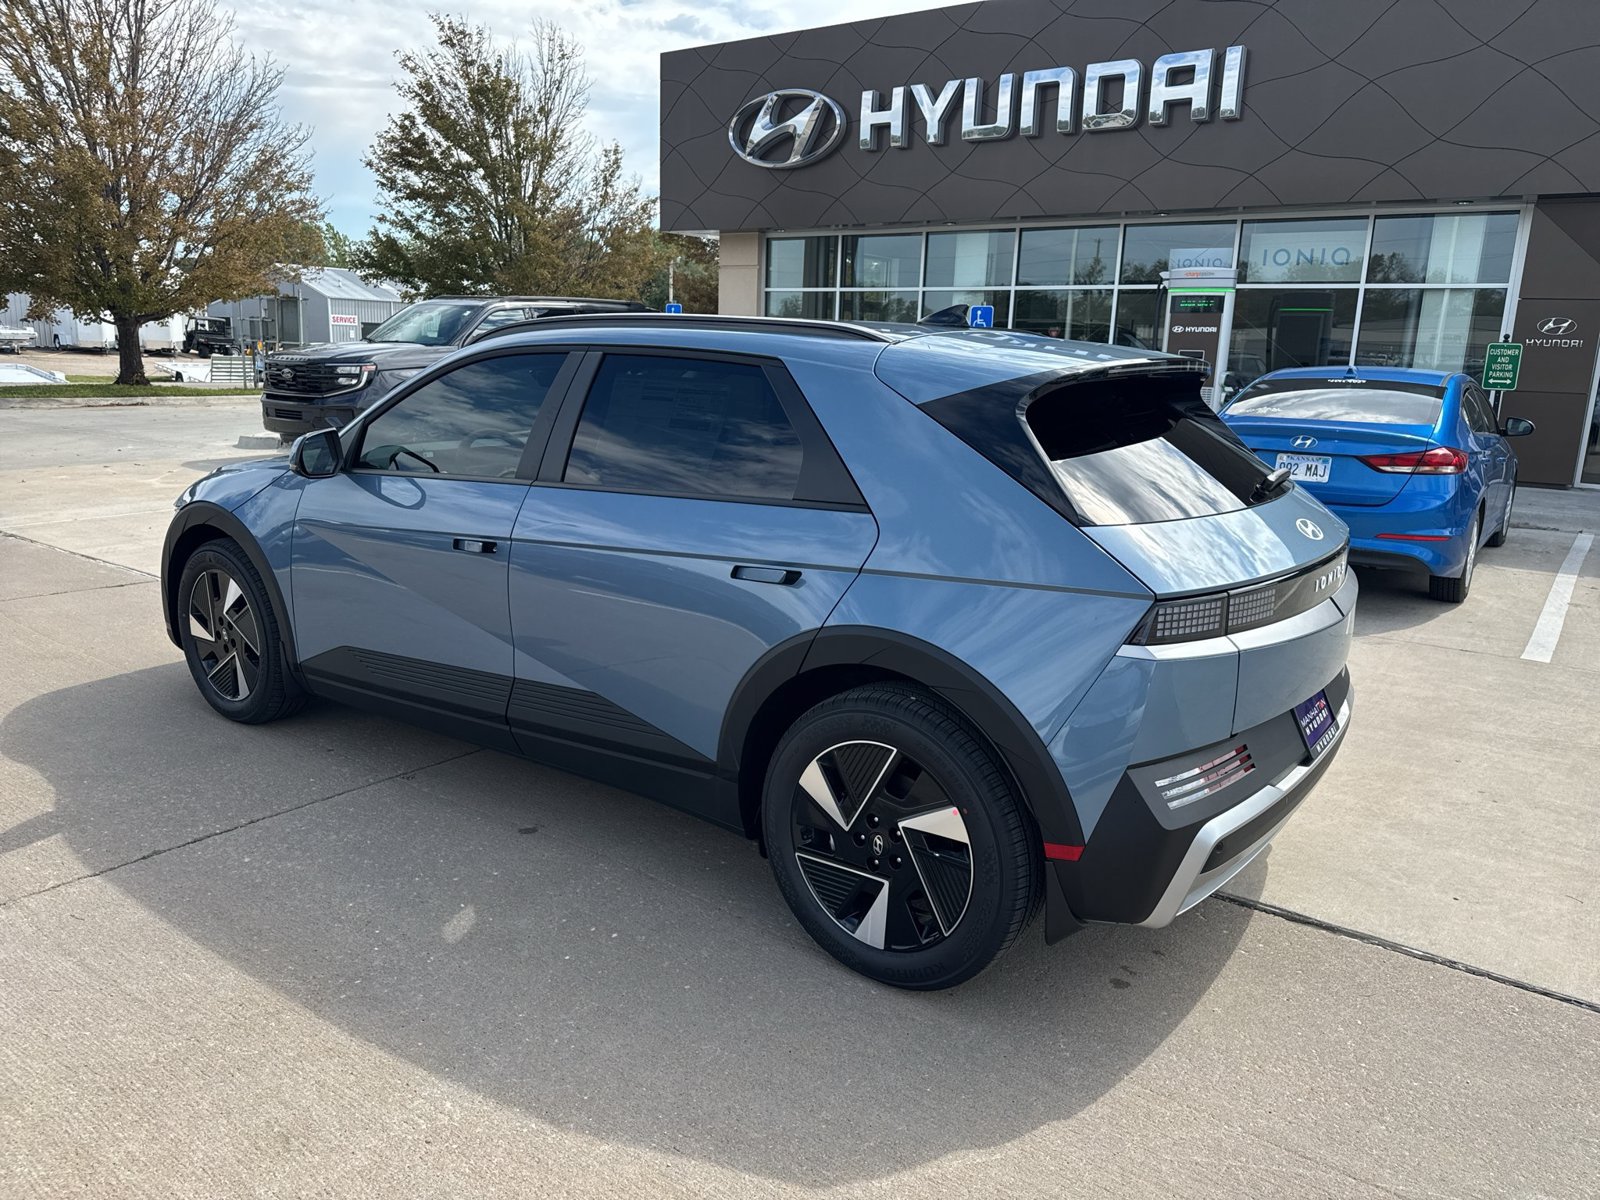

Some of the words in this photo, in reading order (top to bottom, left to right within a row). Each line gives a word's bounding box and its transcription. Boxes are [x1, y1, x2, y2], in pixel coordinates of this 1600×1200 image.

[859, 44, 1248, 151] HYUNDAI
[1262, 247, 1350, 266] IONIQ
[332, 315, 357, 324] SERVICE
[1525, 338, 1584, 348] HYUNDAI
[1489, 348, 1520, 356] CUSTOMER
[1491, 363, 1513, 371] VISITOR
[1488, 370, 1514, 378] PARKING
[1305, 463, 1327, 478] MAJ
[1305, 707, 1329, 736] HYUNDAI
[1315, 725, 1337, 753] HYUNDAI
